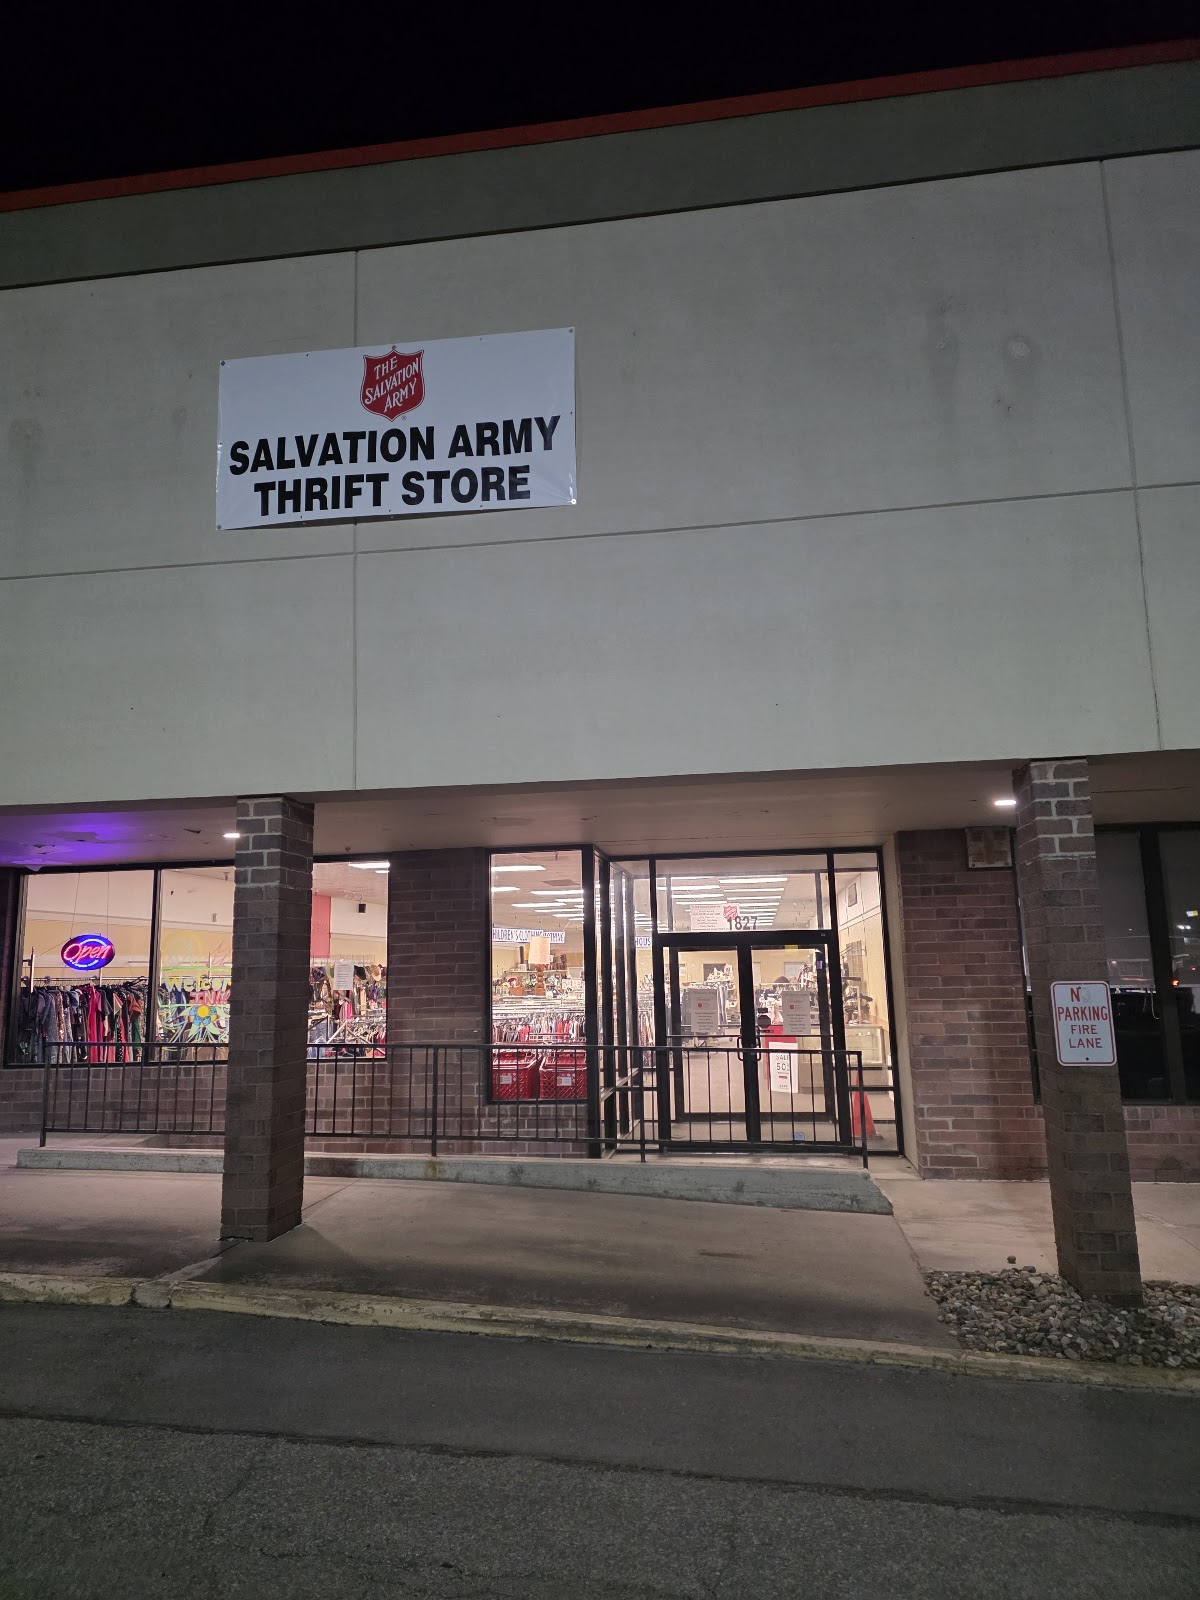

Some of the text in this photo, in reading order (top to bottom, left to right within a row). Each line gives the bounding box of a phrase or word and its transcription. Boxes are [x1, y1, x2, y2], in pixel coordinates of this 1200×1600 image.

[374, 356, 398, 380] THE
[364, 357, 419, 404] SALVATION
[383, 377, 417, 414] ARMY
[229, 415, 561, 475] SALVATION ARMY
[254, 464, 531, 517] THRIFT STORE
[727, 915, 758, 931] 1827
[63, 943, 112, 964] Open
[1057, 1005, 1109, 1022] PARKING
[1070, 1024, 1099, 1035] FIRE
[1068, 1037, 1103, 1049] LANE
